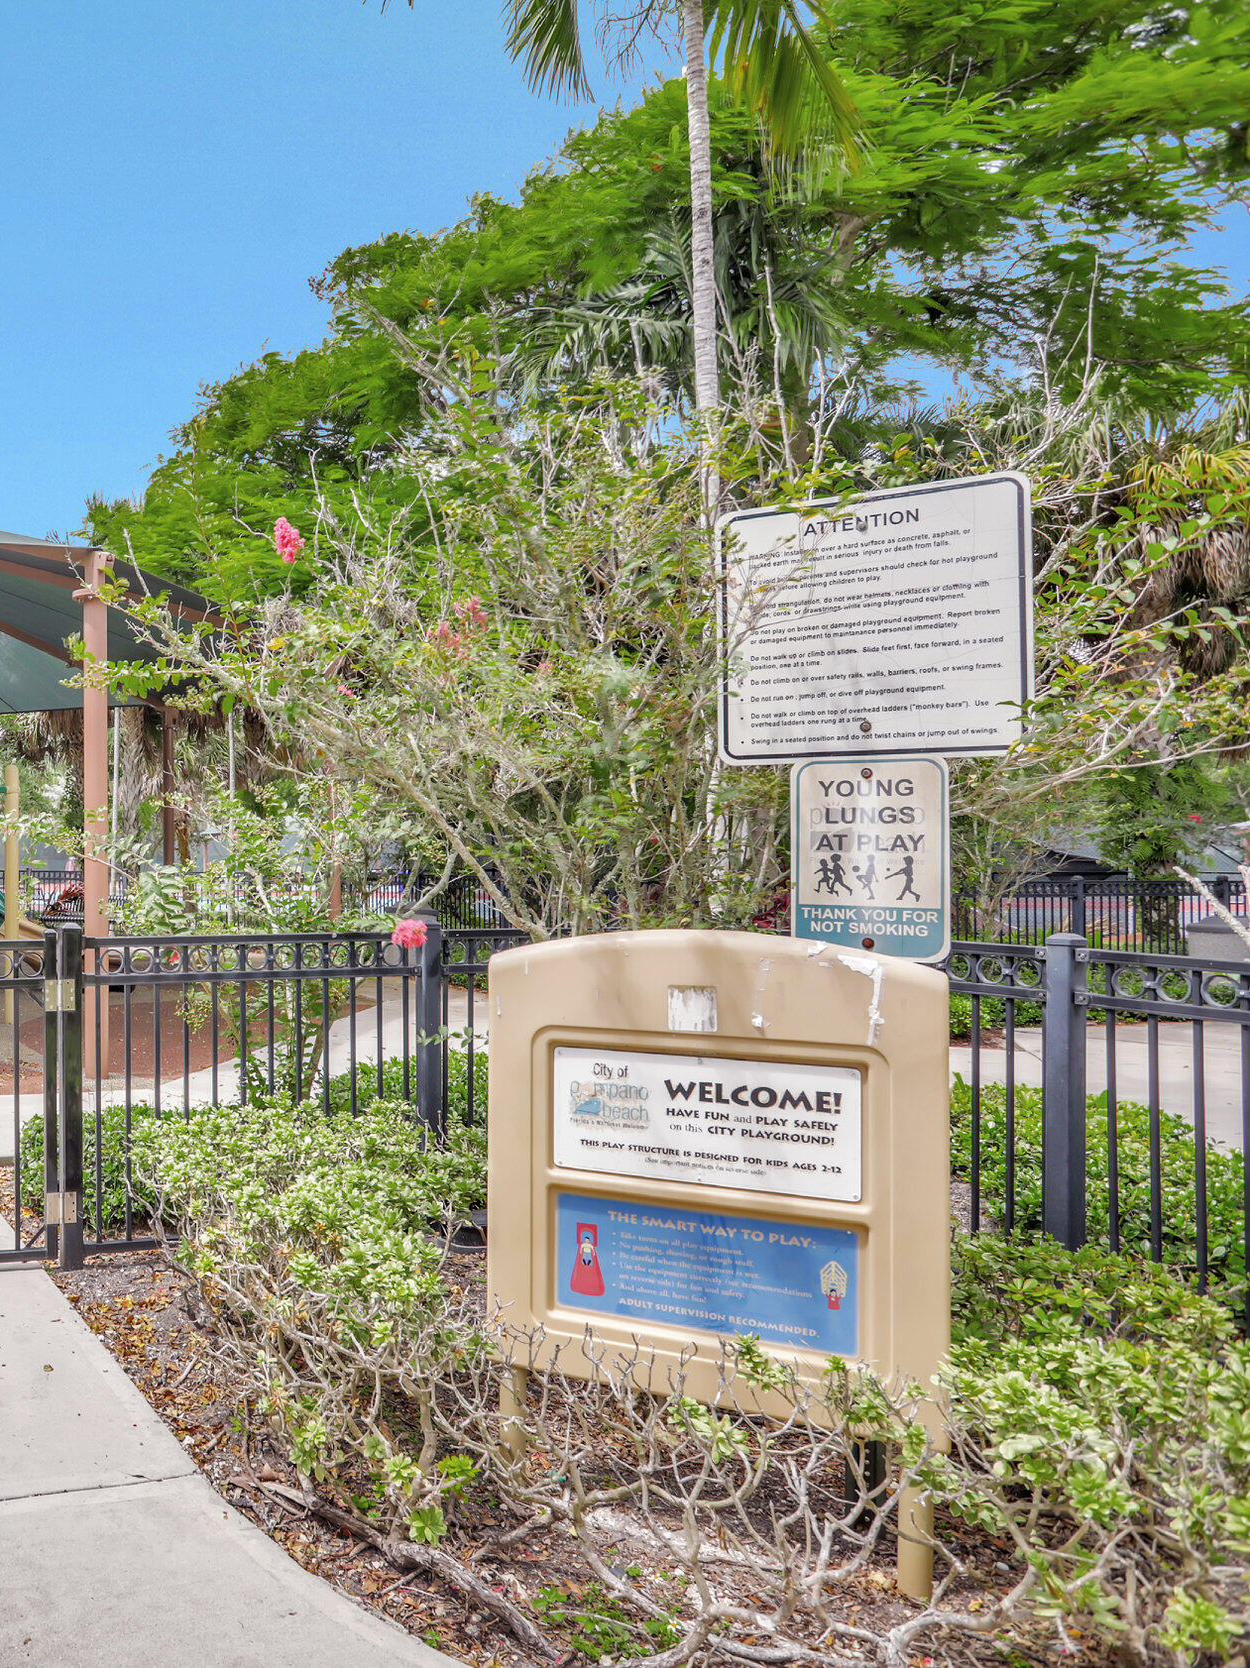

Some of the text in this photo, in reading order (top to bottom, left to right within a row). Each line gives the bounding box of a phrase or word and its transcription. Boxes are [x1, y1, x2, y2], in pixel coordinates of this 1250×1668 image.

[804, 508, 919, 536] ATTENTION
[863, 617, 901, 626] playground
[904, 613, 944, 623] equipment.
[948, 611, 972, 619] Report
[974, 608, 1000, 616] broken
[865, 687, 904, 696] playground
[906, 685, 946, 693] equipment.
[818, 779, 914, 798] YOUNG
[825, 806, 915, 824] LUNGS
[816, 834, 925, 851] AT PLAY
[802, 907, 938, 923] THANK YOU FOR
[810, 921, 928, 936] NOT SMOKING
[593, 1063, 628, 1079] City of
[664, 1079, 842, 1114] WELCOME!
[602, 1100, 648, 1121] beach
[666, 1107, 838, 1132] HAVE FUN and PLAY SAFELY
[670, 1123, 835, 1146] on this CITY PLAYGROUND!
[580, 1139, 599, 1147] THIS
[628, 1144, 680, 1156] STRUCTURE
[695, 1152, 739, 1162] DESIGNED
[743, 1156, 762, 1164] FOR
[792, 1162, 817, 1171] AGES
[822, 1165, 842, 1173] 2-12
[607, 1210, 816, 1249] THE SMART WAY TO PLAY:
[619, 1298, 820, 1338] ADULT SUPERVISION RECOMMENDED.
